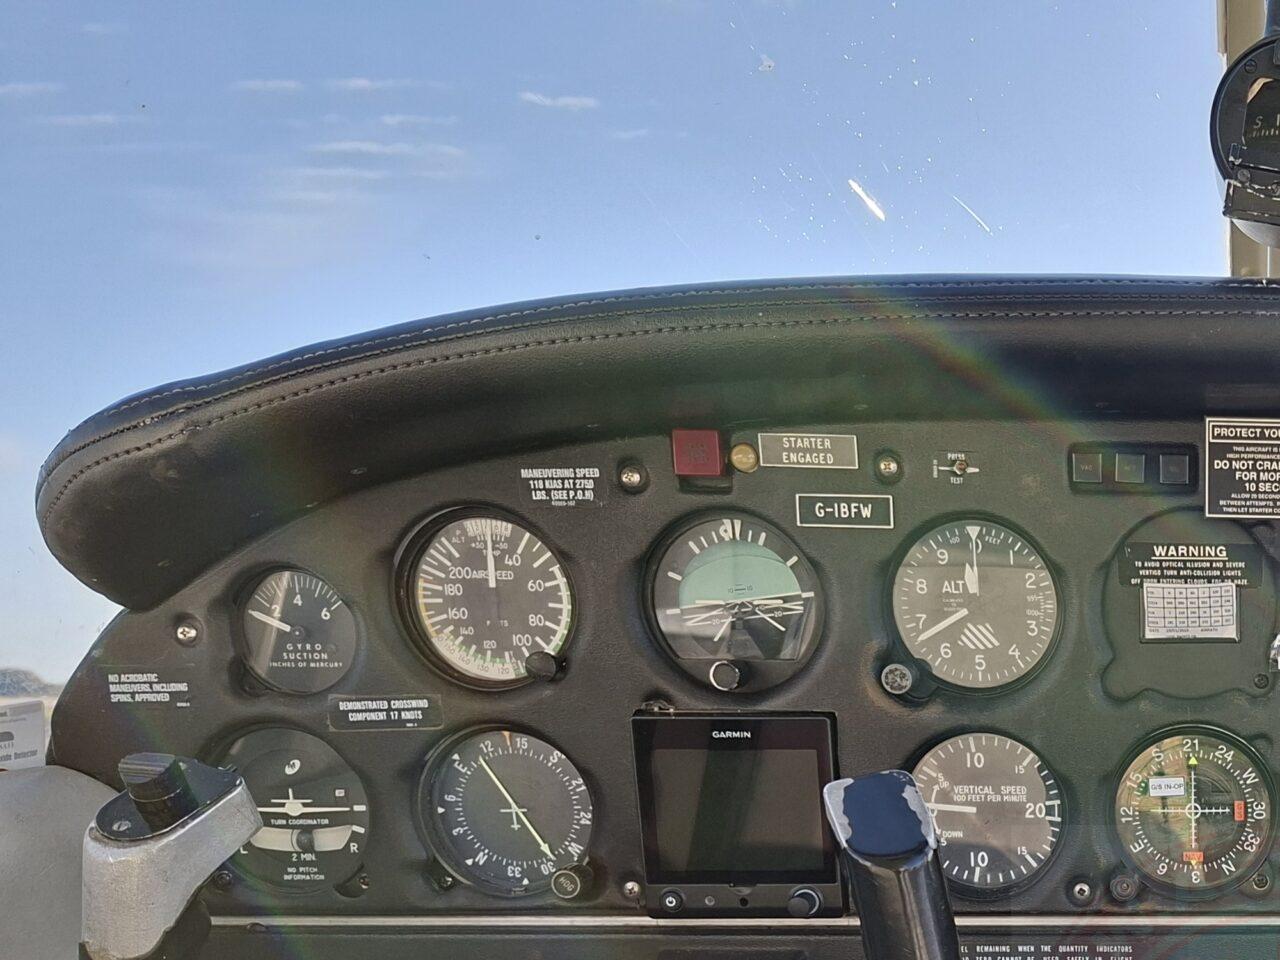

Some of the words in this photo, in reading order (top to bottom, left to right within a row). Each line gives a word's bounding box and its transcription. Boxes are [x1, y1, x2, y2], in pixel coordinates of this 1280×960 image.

[1213, 427, 1261, 438] PROTECT
[782, 437, 832, 449] STARTER
[782, 452, 835, 465] ENGAGED
[1214, 460, 1230, 470] DO
[1232, 460, 1254, 471] NOT
[520, 468, 574, 478] MANEUVERING
[575, 468, 600, 478] SPEED
[1235, 471, 1257, 481] FOR
[529, 479, 544, 489] 118
[545, 479, 562, 489] KIAS
[1245, 482, 1256, 492] 10
[531, 490, 550, 500] LBS.
[551, 490, 568, 500] (SEE
[815, 502, 872, 519] G-IBFW
[936, 548, 949, 565] 9
[1153, 546, 1228, 558] WARNING
[505, 555, 521, 566] 40
[448, 567, 471, 580] 200
[527, 580, 544, 592] 60
[915, 578, 928, 594] 8
[1025, 572, 1037, 589] 2
[444, 584, 464, 596] 180
[943, 580, 965, 594] ALT
[448, 608, 468, 620] 160
[528, 615, 545, 627] 80
[1027, 619, 1039, 636] 3
[483, 639, 497, 649] 120
[512, 634, 532, 645] 100
[283, 652, 328, 660] SUCTION
[940, 643, 952, 659] 6
[1008, 644, 1021, 660] 4
[975, 655, 986, 671] 5
[120, 673, 158, 682] ACROBATIC
[152, 682, 188, 692] INCLUDING
[134, 692, 169, 702] APPROVED
[338, 700, 388, 710] DEMONSTRATED
[390, 699, 429, 709] CROSSWIND
[348, 711, 387, 721] COMPONENT
[389, 711, 399, 720] 17
[401, 711, 423, 720] KNOTS
[712, 731, 751, 739] GARMIN
[1183, 739, 1200, 752] 21
[1214, 745, 1235, 762] 24
[966, 752, 985, 768] 10
[953, 785, 995, 795] VERTICAL
[1001, 785, 1027, 795] SPEED
[953, 794, 967, 802] 100
[1025, 802, 1046, 819] 20
[943, 830, 964, 839] DOWN
[970, 851, 989, 867] 10
[976, 945, 1010, 953] REMAINING
[1018, 945, 1034, 953] WHEN
